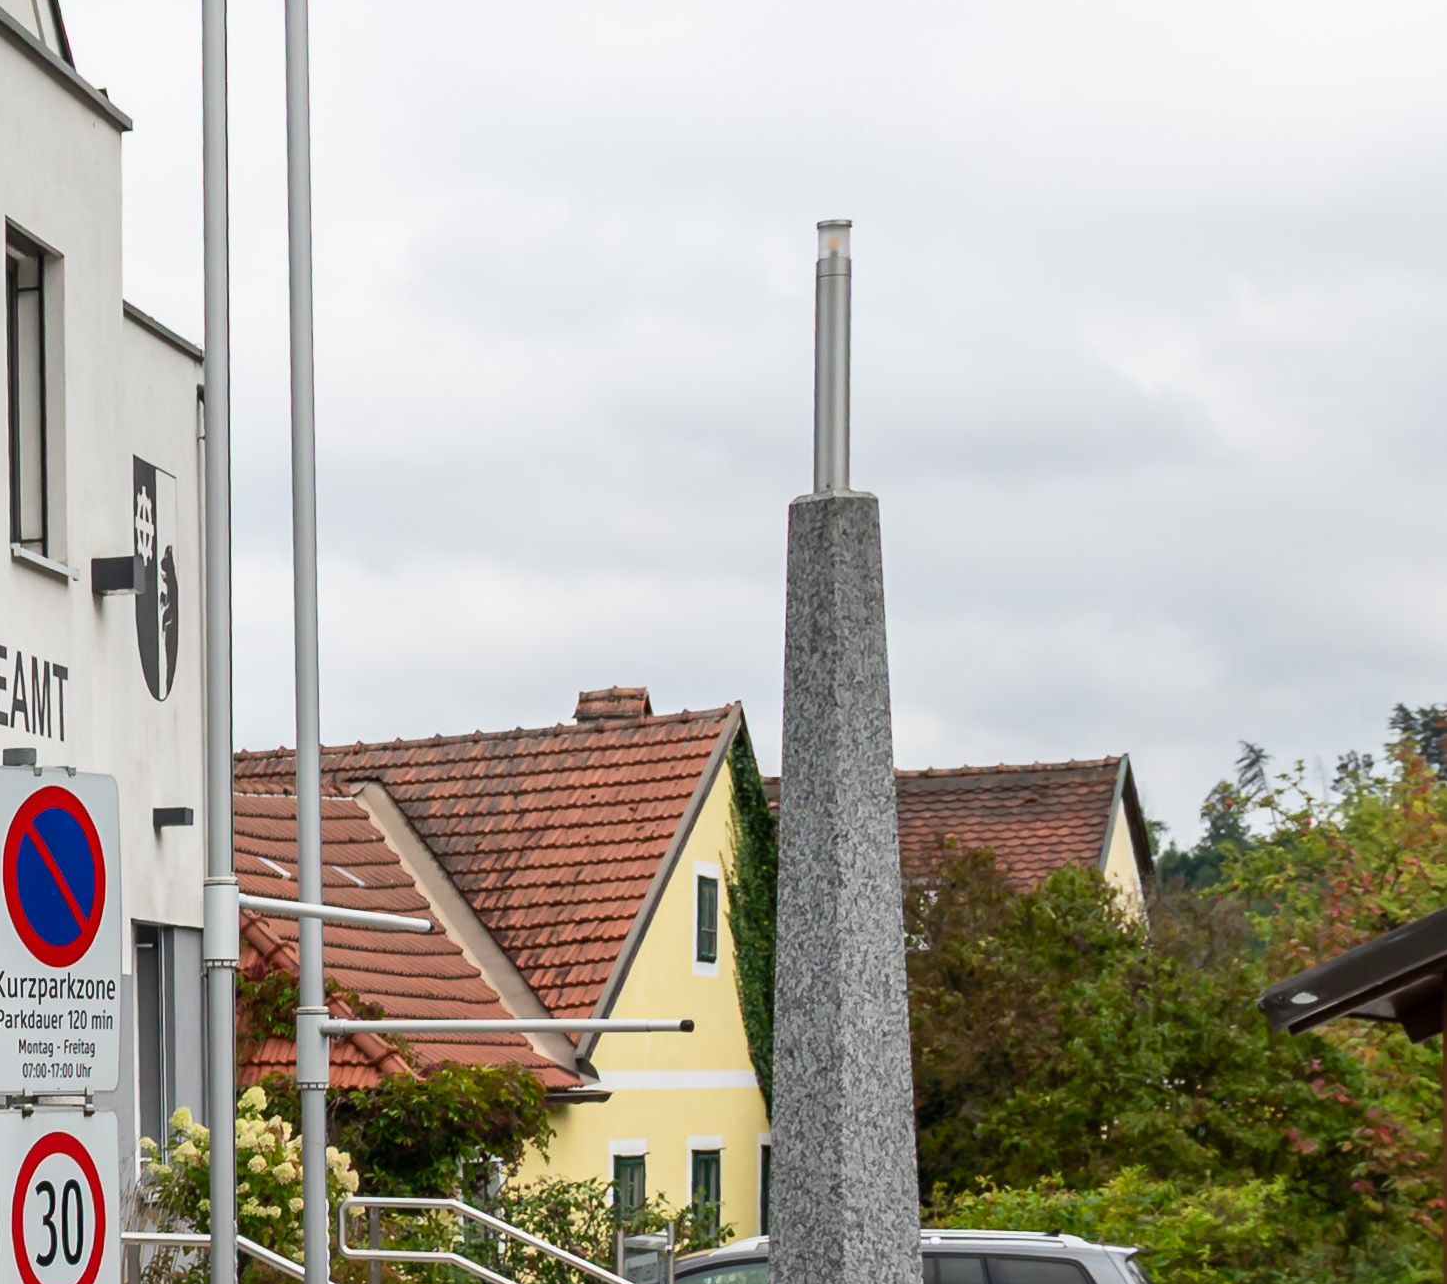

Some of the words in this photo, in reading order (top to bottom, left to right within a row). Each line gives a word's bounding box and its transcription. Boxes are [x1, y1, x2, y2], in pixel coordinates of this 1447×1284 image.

[67, 1009, 87, 1030] 120
[91, 1009, 113, 1030] min
[18, 1038, 54, 1058] Montag
[63, 1038, 96, 1058] Freitag
[75, 1062, 92, 1078] Uhr
[35, 1179, 84, 1267] 30
